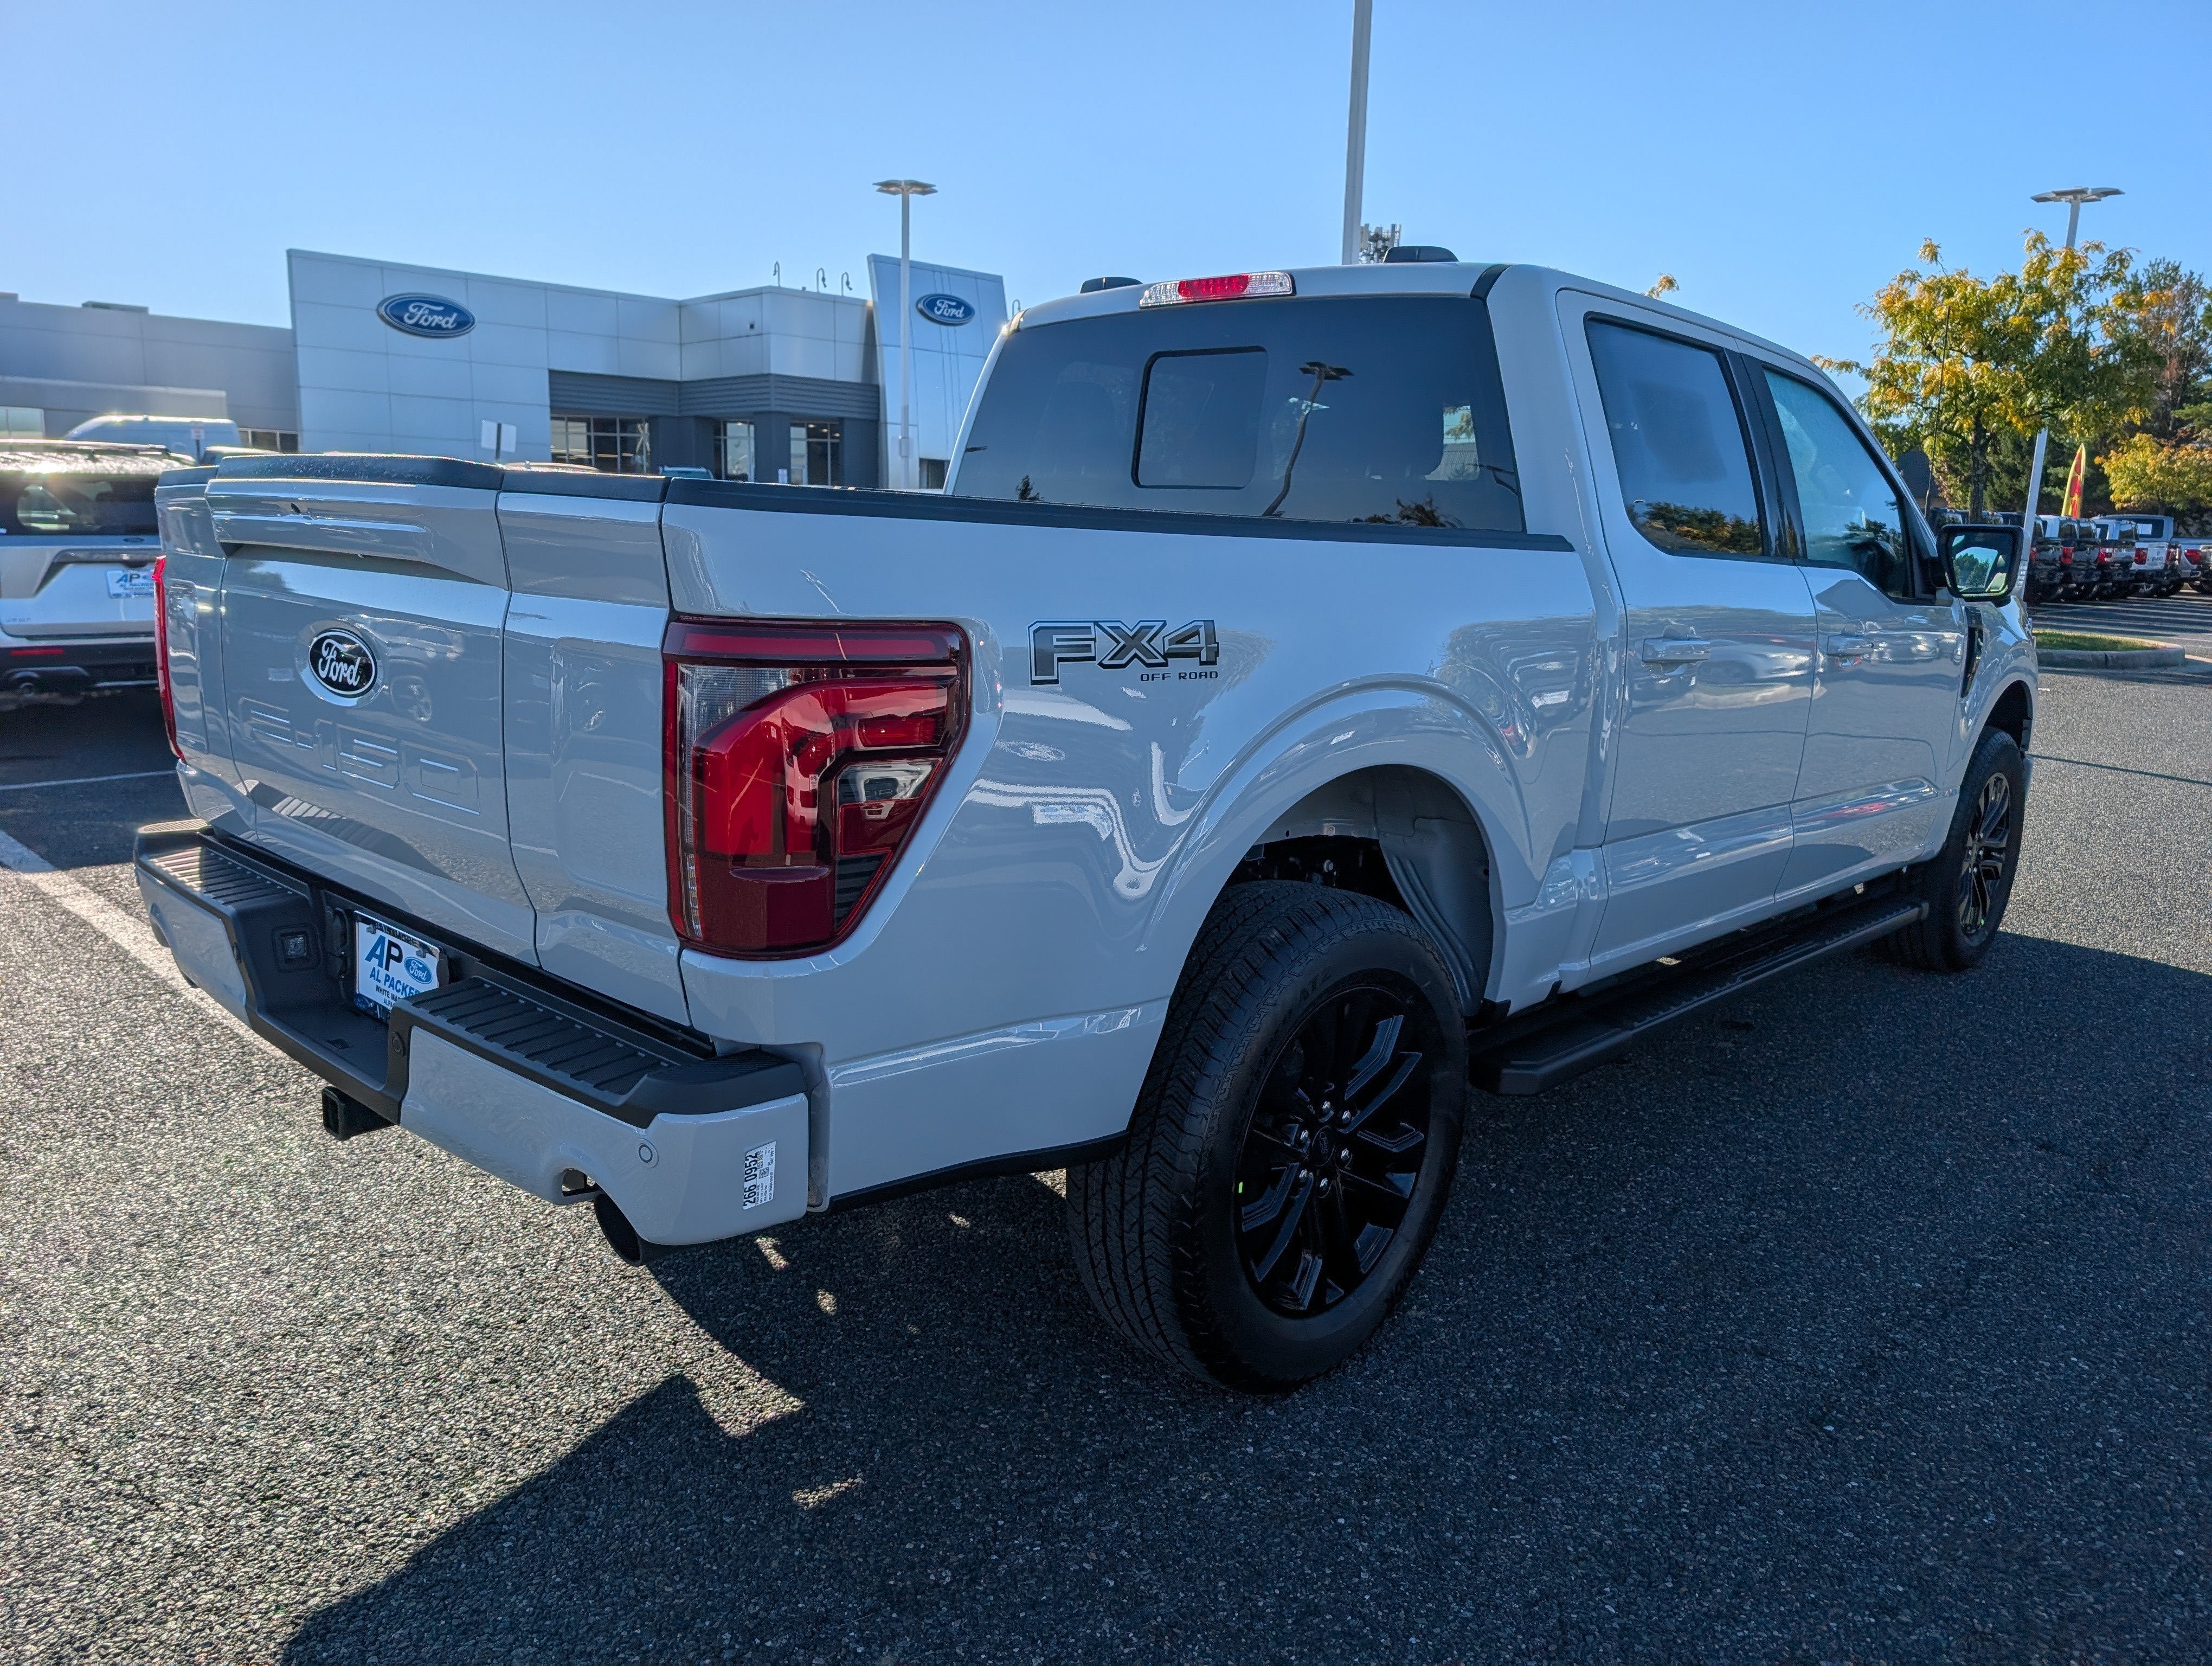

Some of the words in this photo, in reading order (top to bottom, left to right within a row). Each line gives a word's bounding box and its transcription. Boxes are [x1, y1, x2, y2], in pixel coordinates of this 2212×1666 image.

[403, 302, 457, 329] Ford
[934, 299, 965, 318] Ford
[115, 574, 140, 583] AP
[318, 638, 361, 687] Ford
[1027, 619, 1219, 685] FX4
[1140, 672, 1172, 682] OFF
[1178, 671, 1218, 680] ROAD
[364, 934, 403, 972] AP
[369, 966, 381, 983] AL
[409, 959, 427, 981] Ford
[376, 984, 390, 998] WHITE
[744, 1152, 758, 1182] 0952
[743, 1184, 757, 1207] 266
